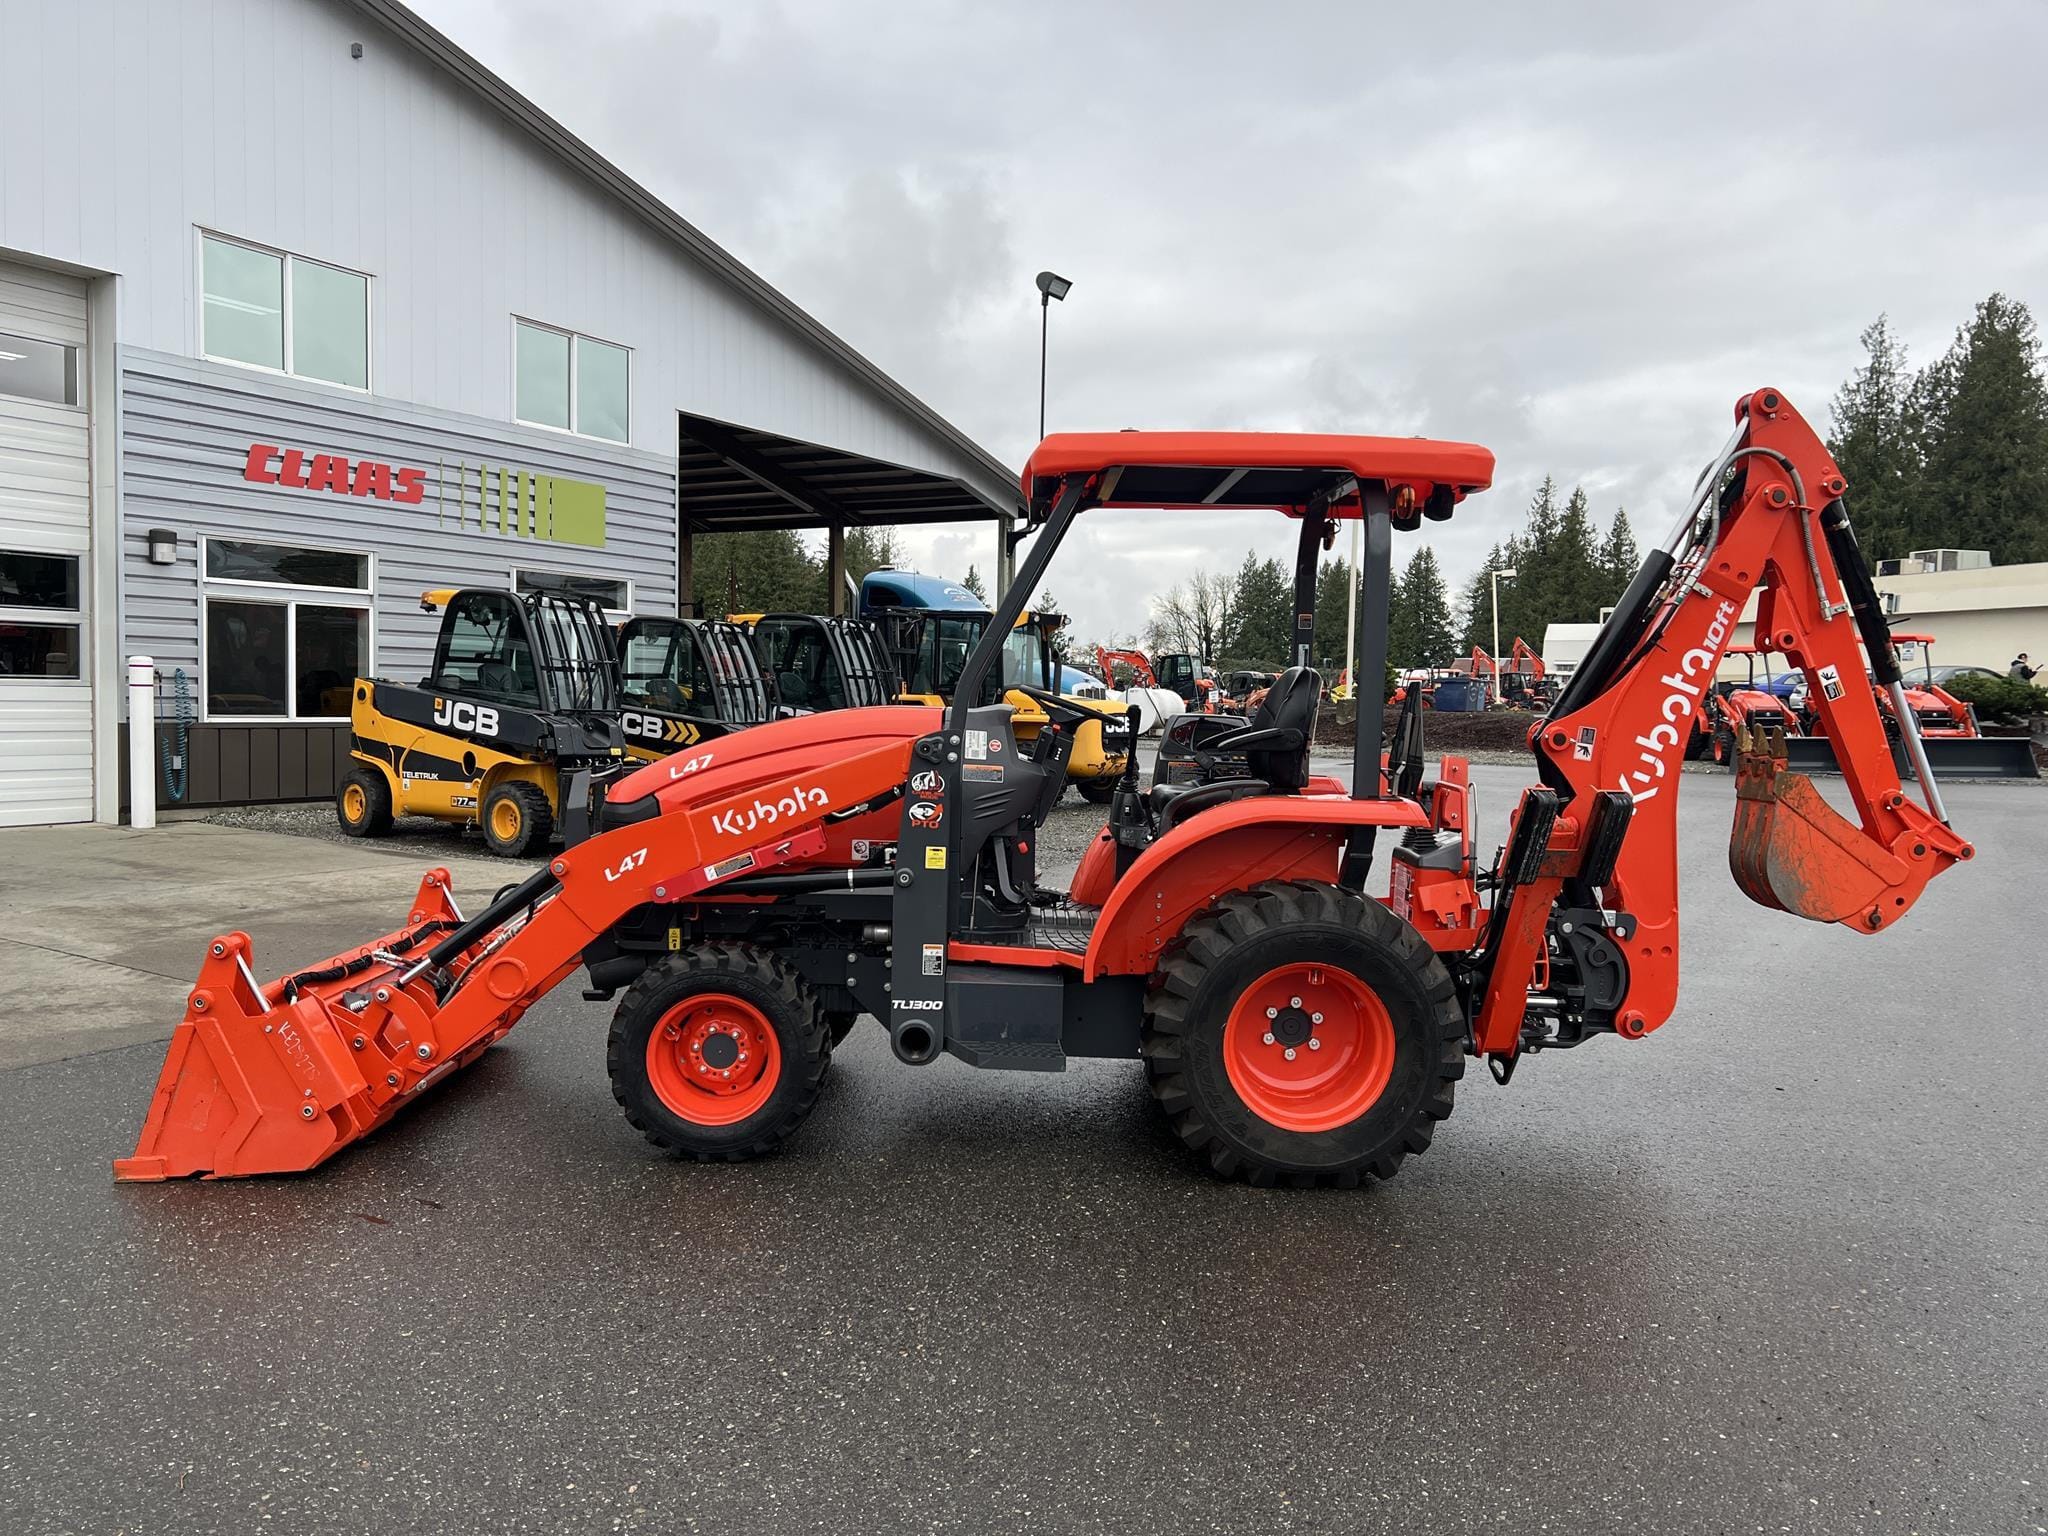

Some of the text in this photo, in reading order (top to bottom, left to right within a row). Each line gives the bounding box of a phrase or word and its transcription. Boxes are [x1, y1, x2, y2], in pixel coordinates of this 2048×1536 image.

[244, 443, 426, 505] CLAAS
[433, 698, 500, 737] JCB
[1618, 601, 1735, 816] Kubota 10ft
[617, 711, 663, 739] CB
[402, 771, 438, 780] TELETRUK
[669, 753, 714, 780] L47
[711, 786, 829, 835] Kubota
[911, 819, 939, 829] PTO
[604, 847, 648, 882] L47
[891, 999, 943, 1010] TL1300
